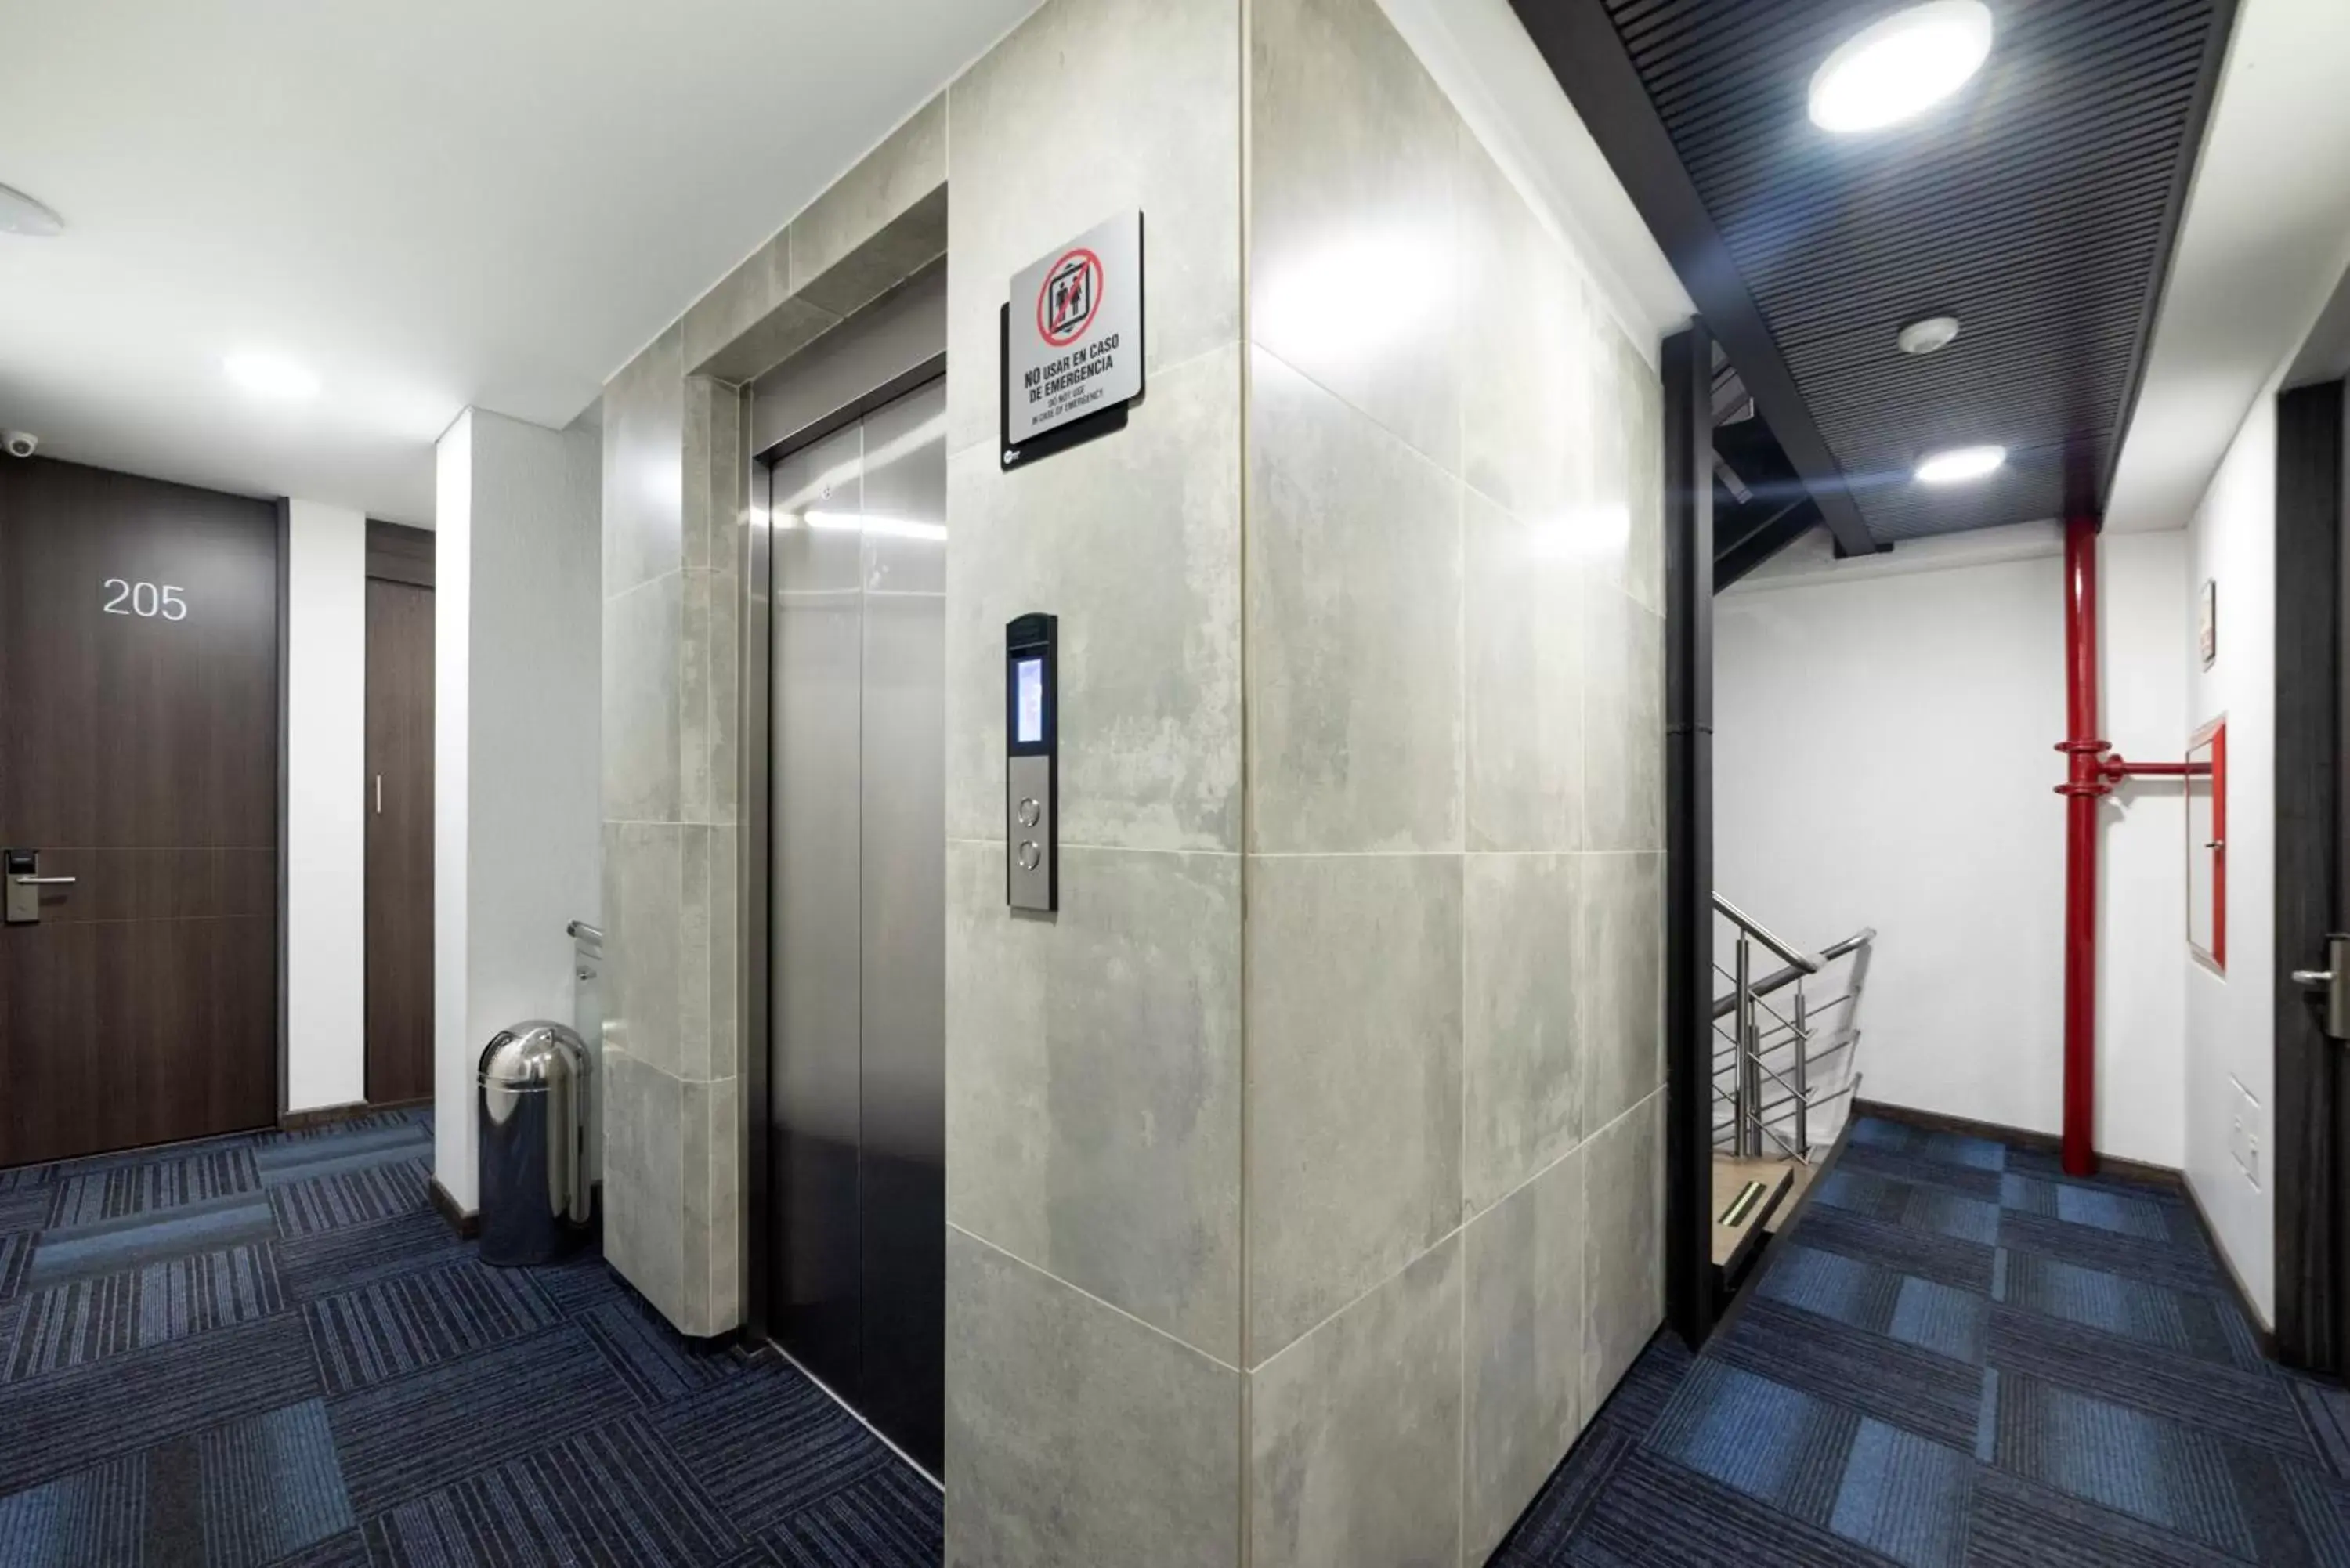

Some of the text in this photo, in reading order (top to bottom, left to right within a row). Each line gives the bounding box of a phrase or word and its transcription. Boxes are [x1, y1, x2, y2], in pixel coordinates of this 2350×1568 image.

[1025, 333, 1119, 388] NO USAR EN CASO
[1030, 355, 1113, 403] DE EMERGENCIA
[103, 579, 187, 620] 205
